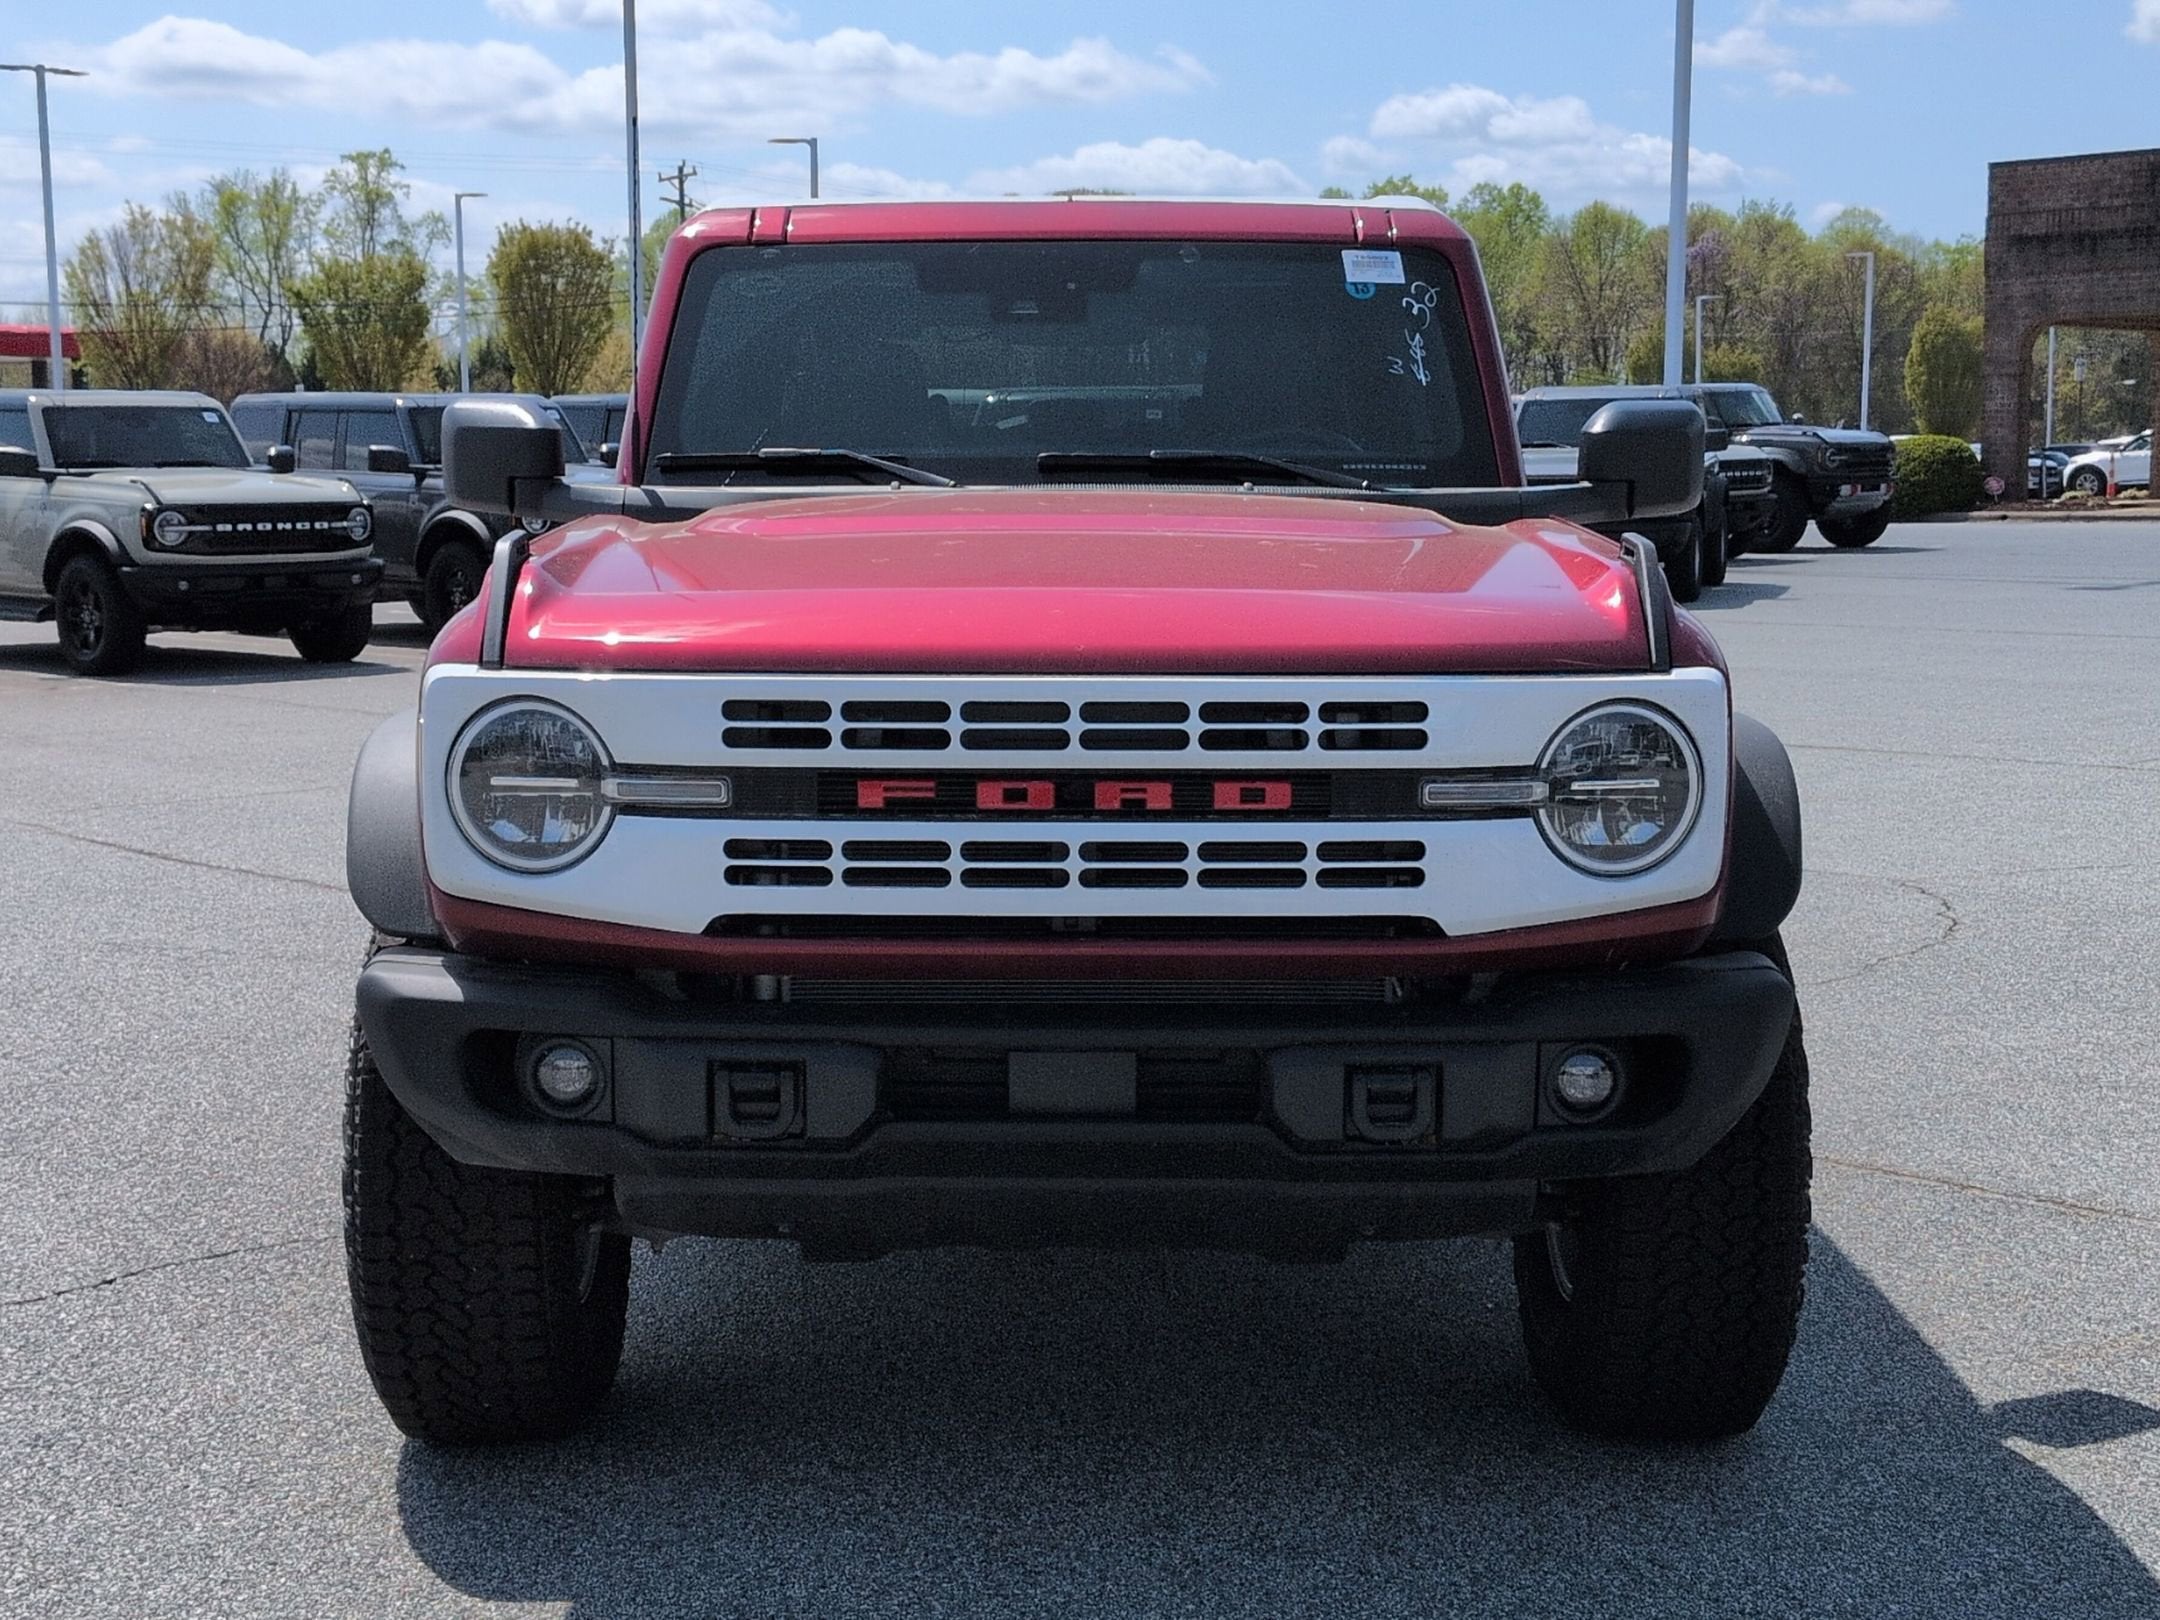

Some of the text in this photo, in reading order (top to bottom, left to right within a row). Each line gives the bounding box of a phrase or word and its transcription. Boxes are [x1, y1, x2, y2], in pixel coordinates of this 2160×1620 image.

[1402, 281, 1440, 330] 32
[216, 521, 329, 532] BRONCO
[857, 779, 1292, 810] FORD
